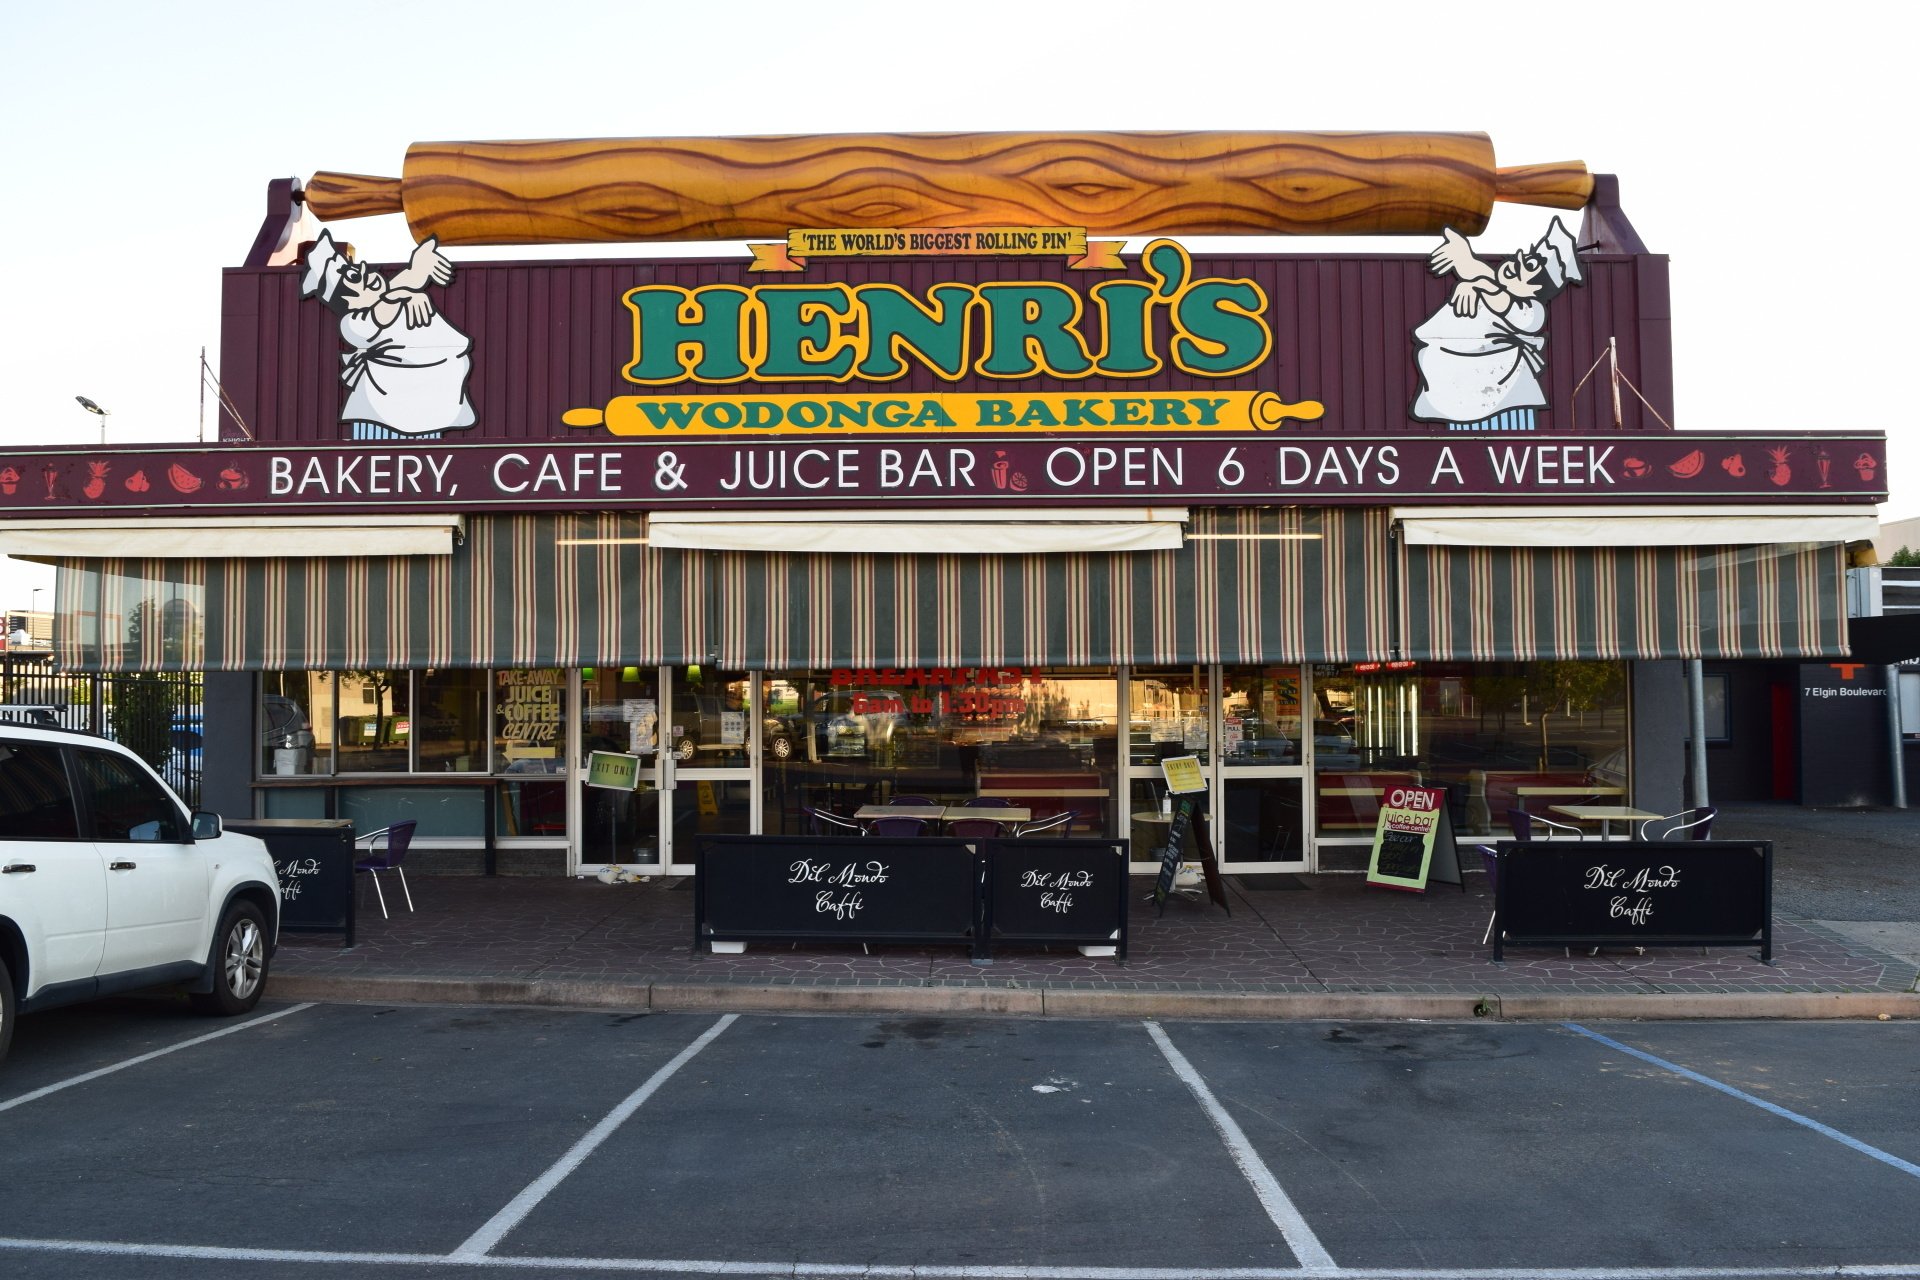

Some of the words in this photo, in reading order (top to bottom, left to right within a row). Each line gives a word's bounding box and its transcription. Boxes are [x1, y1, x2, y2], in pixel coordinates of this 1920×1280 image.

[841, 232, 906, 251] WORLD'S
[909, 232, 971, 250] BIGGEST
[975, 232, 1038, 250] ROLLING
[622, 238, 1274, 385] HENRI'S
[638, 401, 955, 430] WODONGA
[978, 399, 1228, 427] BAKERY
[270, 453, 459, 497] BAKERY,
[492, 452, 623, 494] CAFE
[654, 450, 689, 491] &
[719, 448, 861, 490] JUICE
[880, 447, 976, 488] BAR
[1045, 446, 1186, 487] OPEN
[1218, 446, 1245, 486] 6
[1279, 445, 1400, 486] DAYS
[1430, 445, 1465, 485] A
[1484, 444, 1617, 485] WEEK
[505, 685, 551, 703] JUICE
[1804, 687, 1811, 697] 7
[1812, 687, 1838, 699] Elgin
[504, 703, 559, 721] COFFEE
[853, 691, 904, 714] 6am
[911, 695, 933, 714] to
[941, 691, 1026, 719] 1:30pm
[502, 721, 560, 741] CENTRE
[614, 764, 635, 777] ONLY
[1390, 789, 1435, 810] OPEN
[1382, 811, 1411, 828] juice
[1414, 813, 1435, 827] bar
[278, 858, 321, 878] Mondo
[788, 858, 831, 883] Del
[827, 861, 890, 888] Mondo
[1020, 869, 1052, 888] Del
[1049, 870, 1094, 891] Mondo
[1583, 864, 1626, 890] Del
[1622, 865, 1681, 893] Mondo
